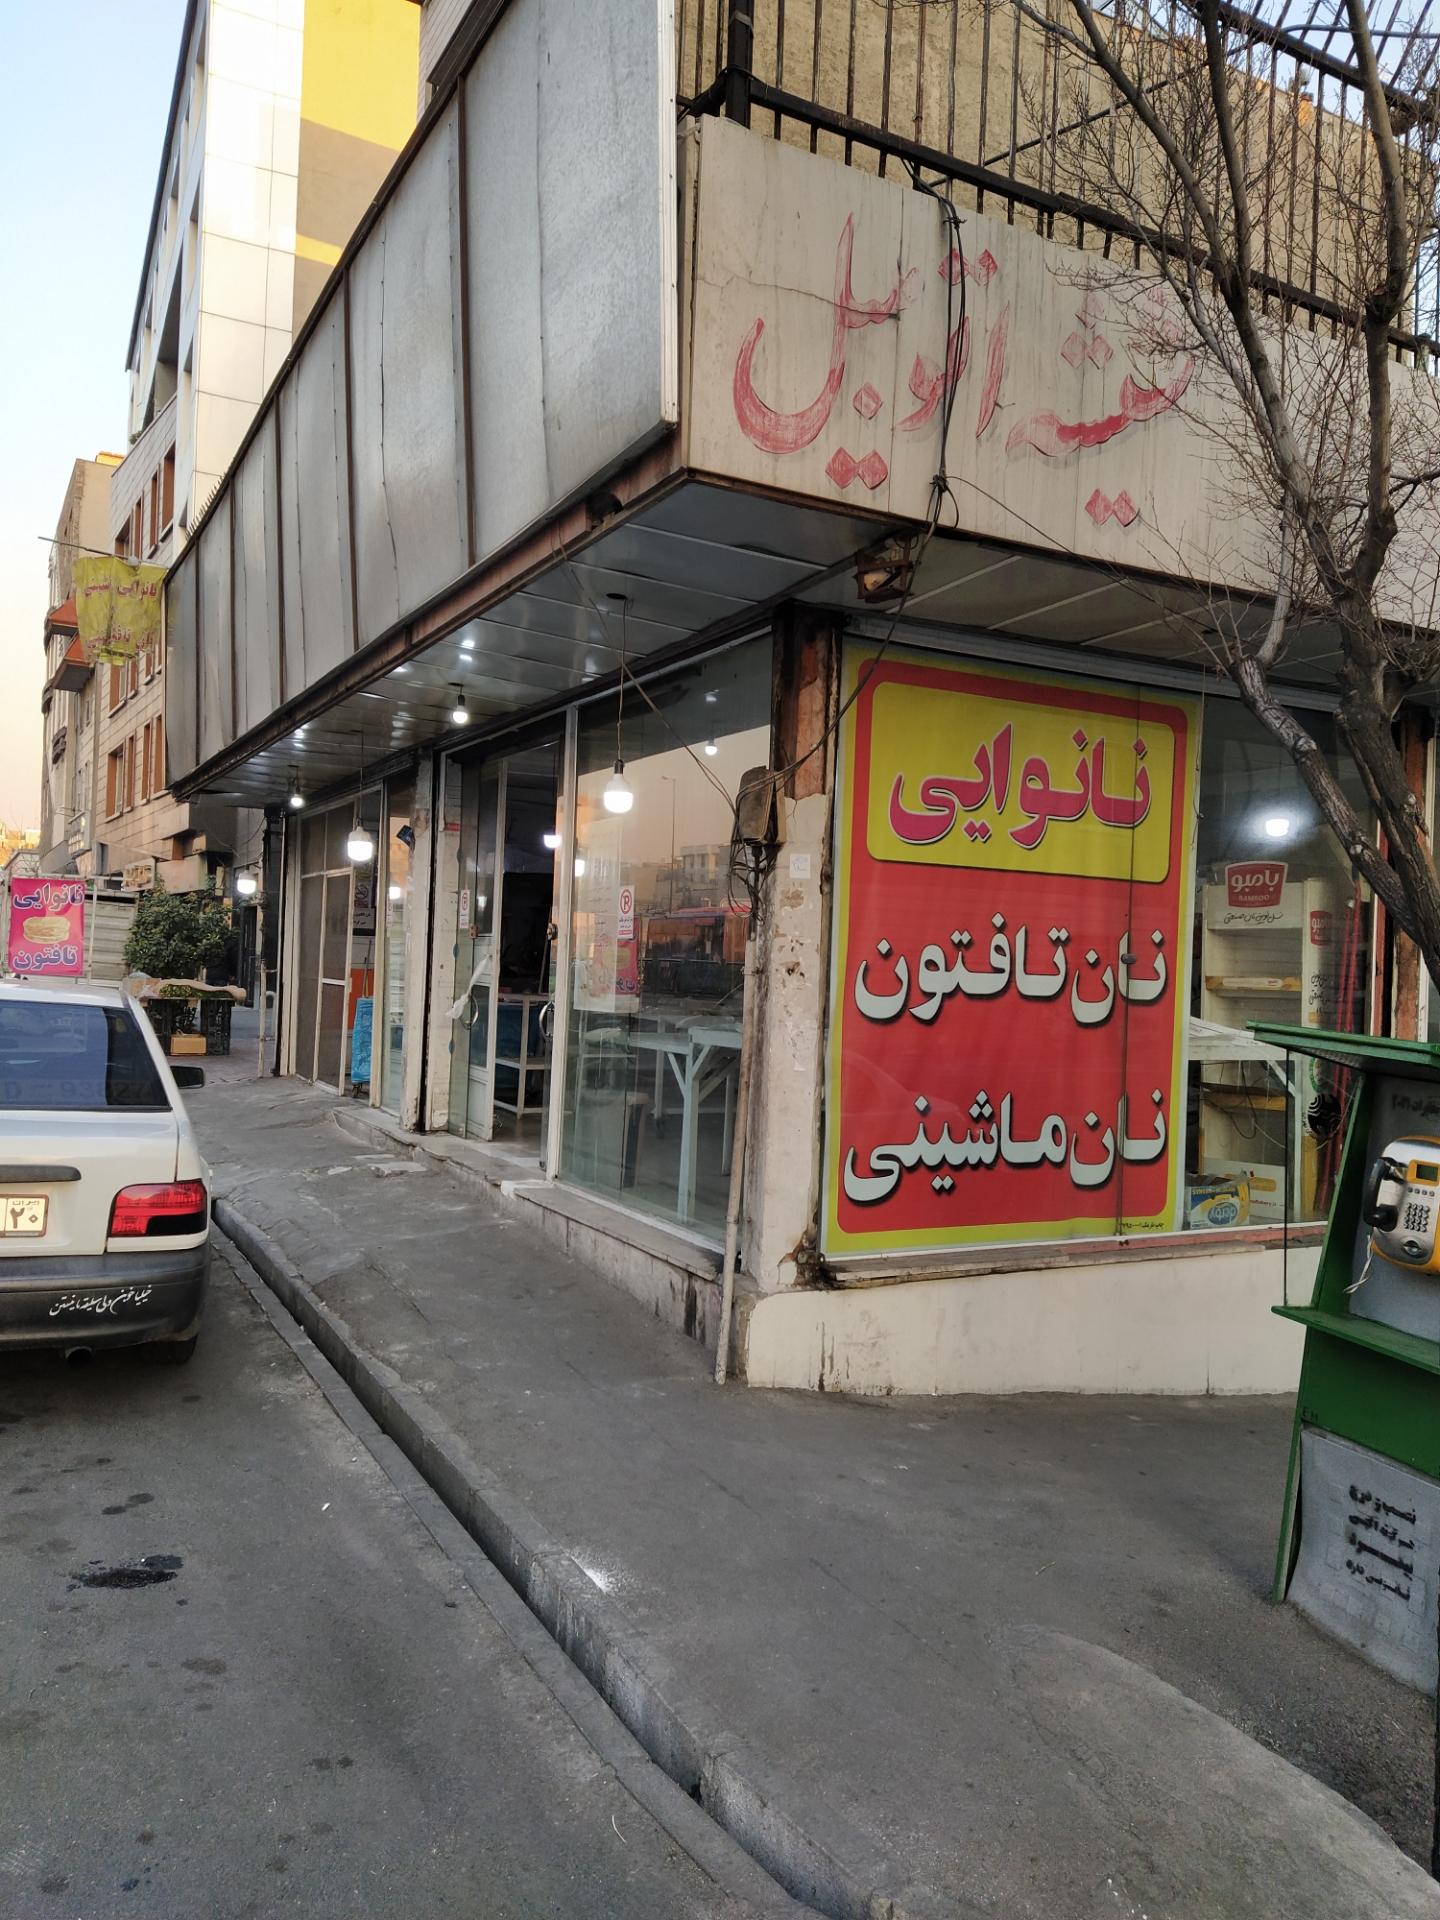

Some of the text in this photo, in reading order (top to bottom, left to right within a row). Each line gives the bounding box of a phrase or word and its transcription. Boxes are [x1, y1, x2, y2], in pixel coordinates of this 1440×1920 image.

[889, 721, 1151, 850] نانوایی
[1231, 869, 1280, 893] بامبو
[13, 883, 84, 911] نانوایی
[13, 944, 78, 971] تافتون
[854, 911, 1167, 1024] نان تافتون
[843, 1089, 1167, 1202] نان ماشینی
[95, 1295, 112, 1312] ولی
